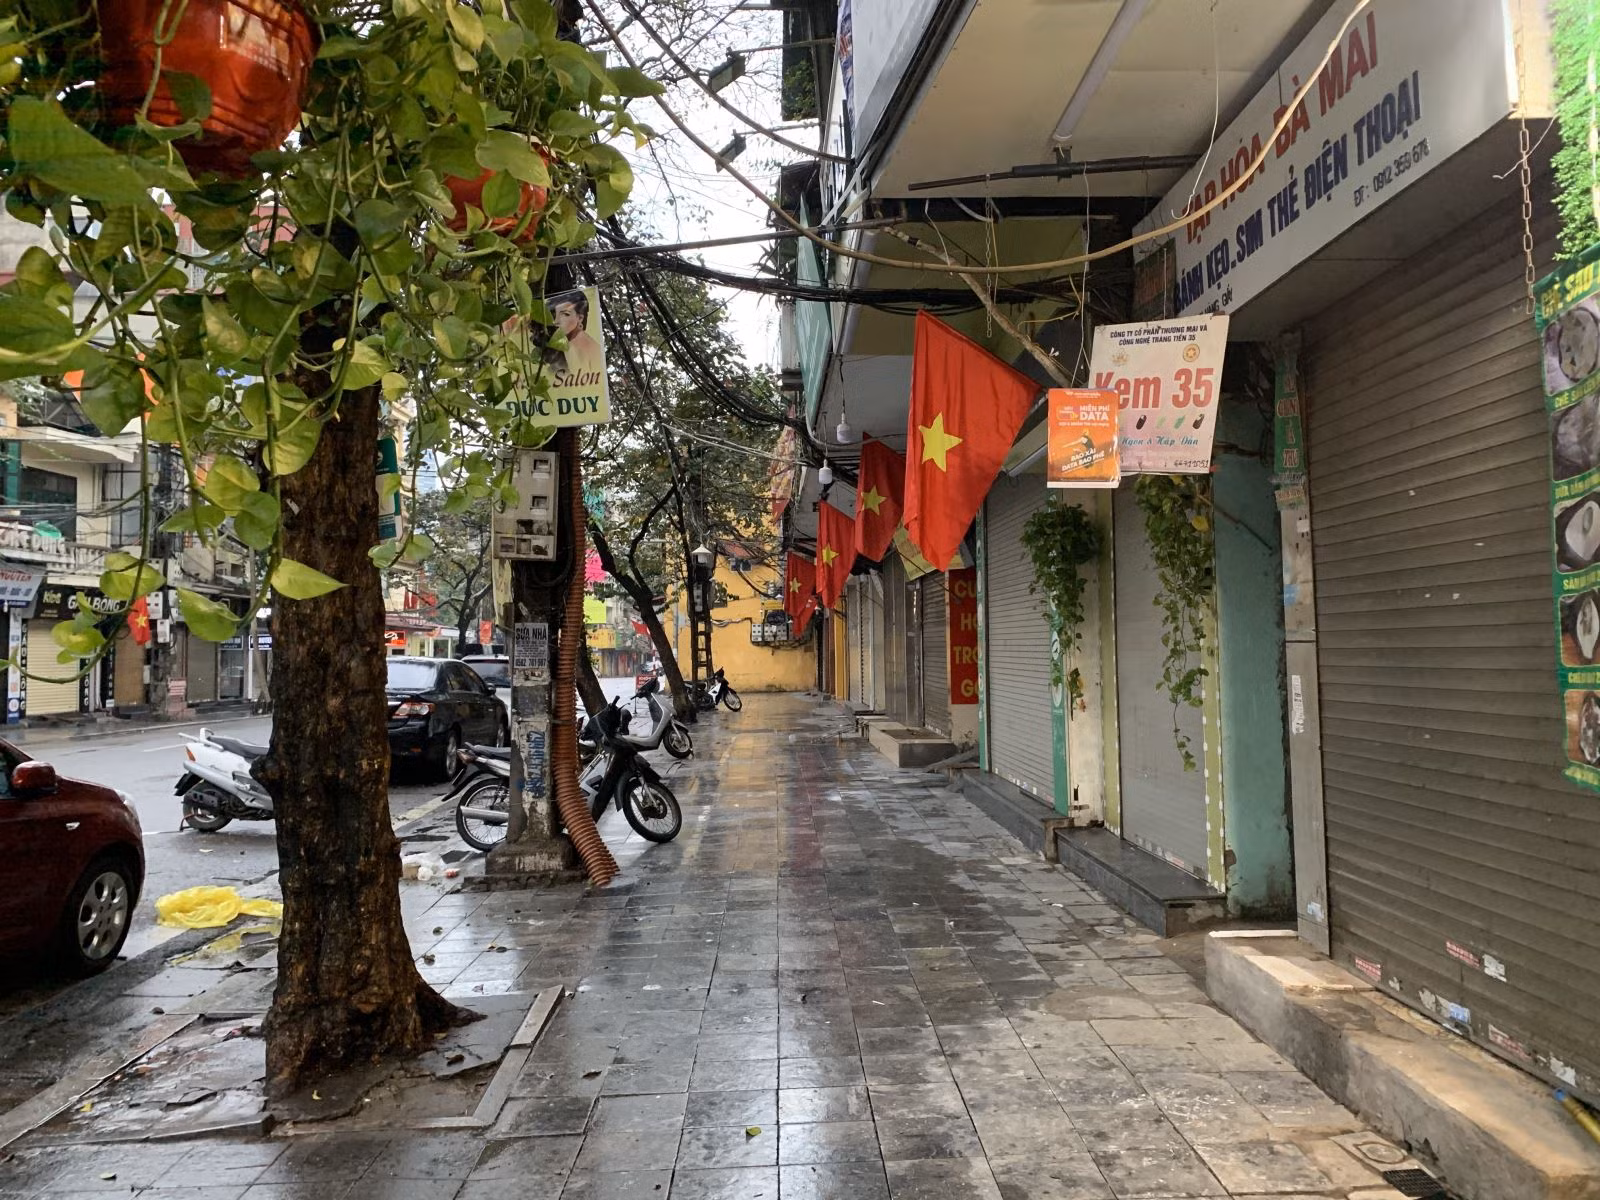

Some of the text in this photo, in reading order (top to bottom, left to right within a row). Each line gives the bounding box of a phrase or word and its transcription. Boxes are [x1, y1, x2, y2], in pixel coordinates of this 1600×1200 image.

[1182, 180, 1216, 244] TẠP
[1273, 75, 1311, 160] BÀ
[1318, 11, 1377, 117] MAI
[1267, 164, 1300, 238] THẺ
[1304, 133, 1349, 210] ĐIỆN
[1353, 70, 1421, 166] THOẠI
[1110, 330, 1126, 339] CÔNG
[552, 368, 601, 389] Salon
[1172, 368, 1214, 409] 35
[557, 396, 599, 415] DUY
[1080, 411, 1109, 421] DATA
[532, 625, 547, 641] NHÀ
